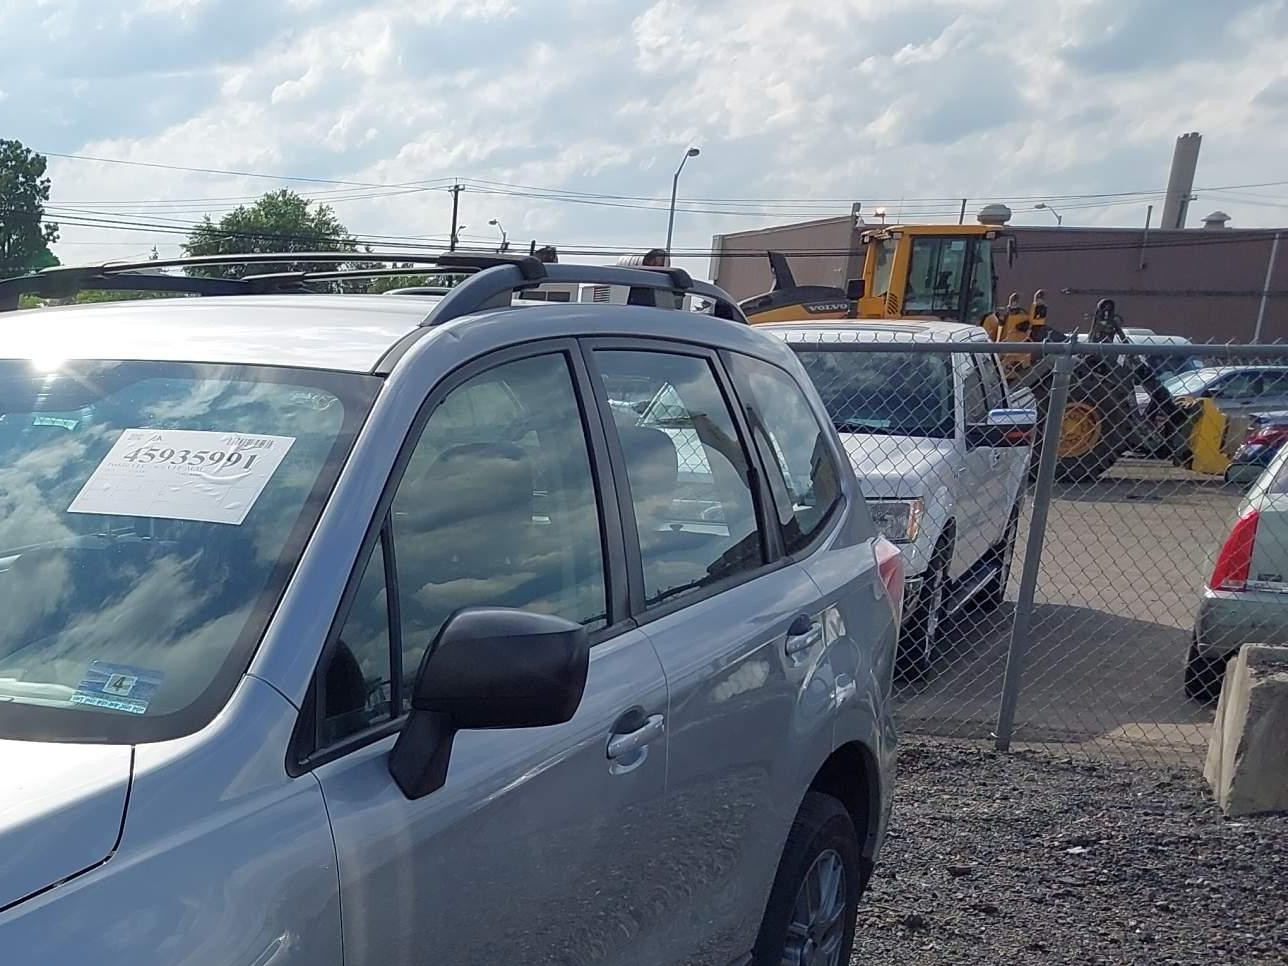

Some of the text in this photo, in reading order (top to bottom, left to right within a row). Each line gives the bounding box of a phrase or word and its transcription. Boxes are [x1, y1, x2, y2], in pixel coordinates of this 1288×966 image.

[809, 303, 848, 311] VOLVO
[123, 446, 258, 470] 45935991
[113, 676, 127, 692] 4
